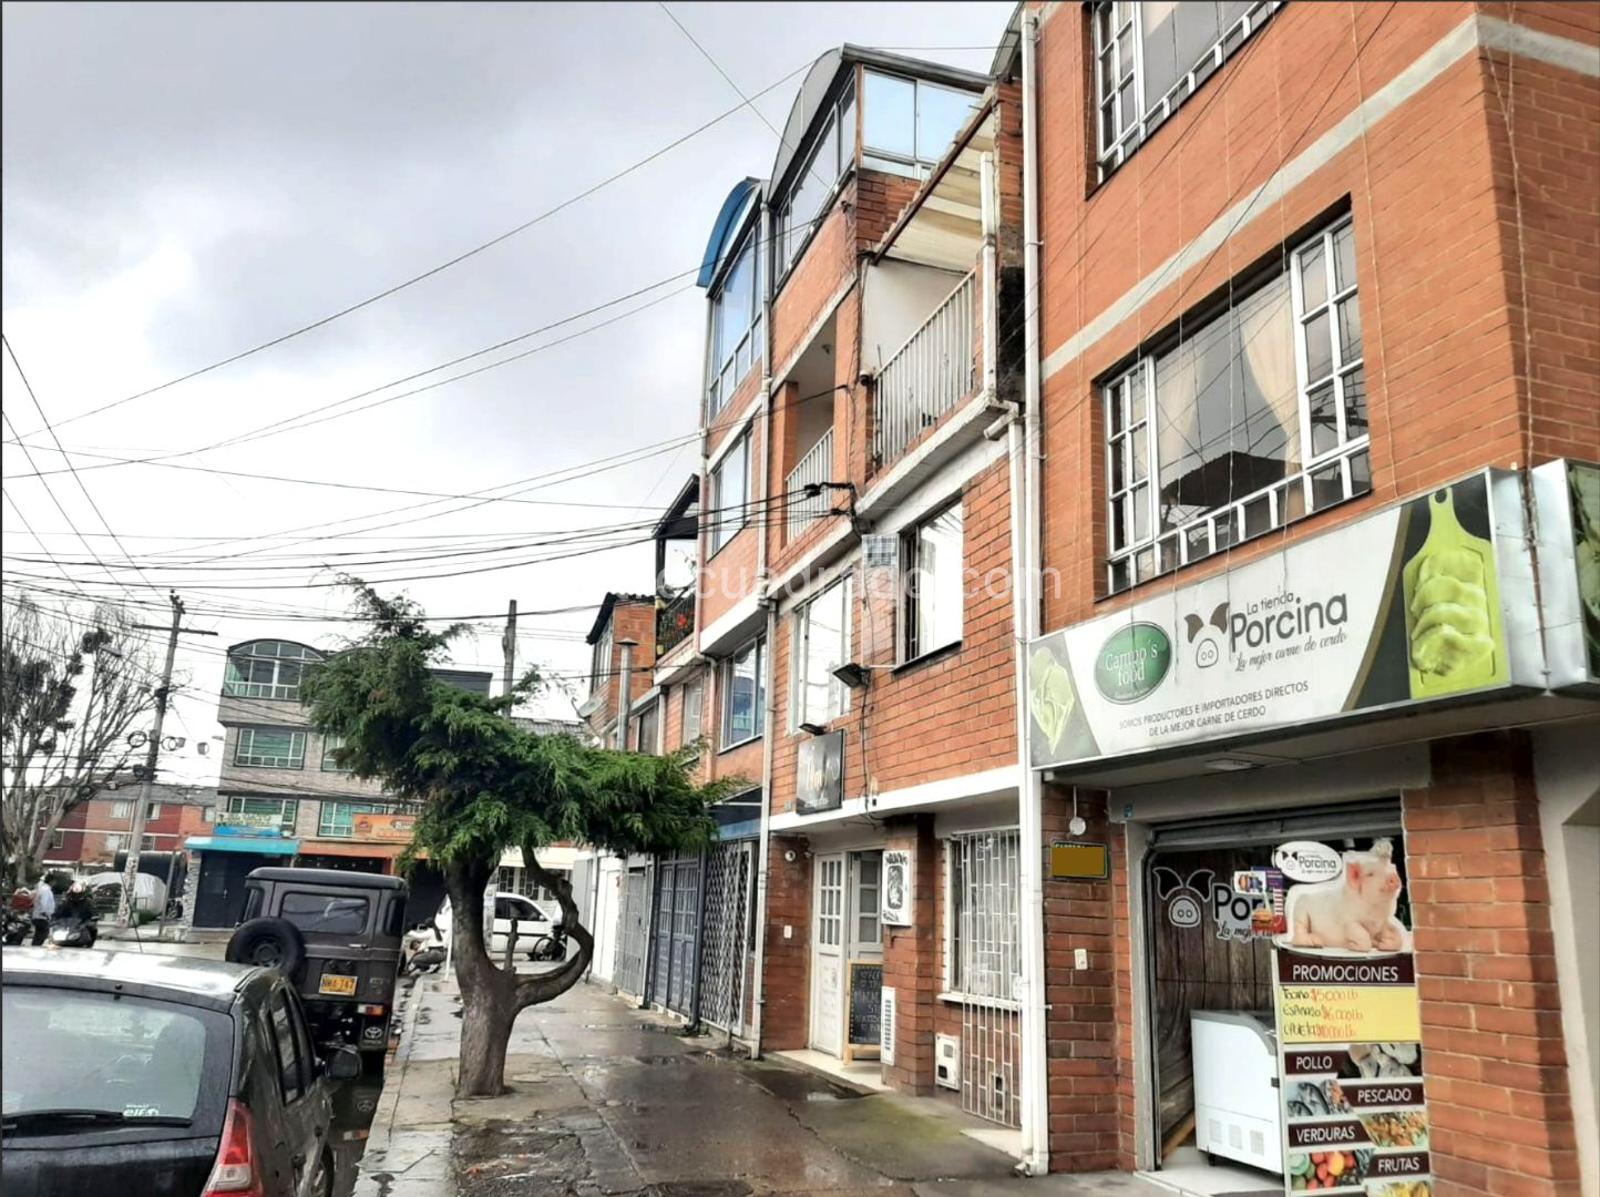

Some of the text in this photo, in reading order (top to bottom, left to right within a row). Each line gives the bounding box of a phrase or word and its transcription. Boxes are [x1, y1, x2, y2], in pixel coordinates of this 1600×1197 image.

[1246, 590, 1294, 616] La tienda
[1231, 593, 1348, 653] Porcina
[1319, 627, 1347, 648] cerdo
[1117, 659, 1146, 687] food
[1119, 681, 1309, 730] SOMOS PRODUCTORES E IMPORTADORES DIRECTOS
[1149, 705, 1266, 737] DE LA MEJOR CARNE DE CERDO
[1299, 855, 1336, 869] Porcina
[1292, 964, 1399, 982] PROMOCIONES
[1296, 1055, 1333, 1070] POLLO
[1357, 1088, 1412, 1103] PESCADO
[1296, 1126, 1356, 1143] VERDURAS
[1378, 1157, 1421, 1173] FRUTAS
